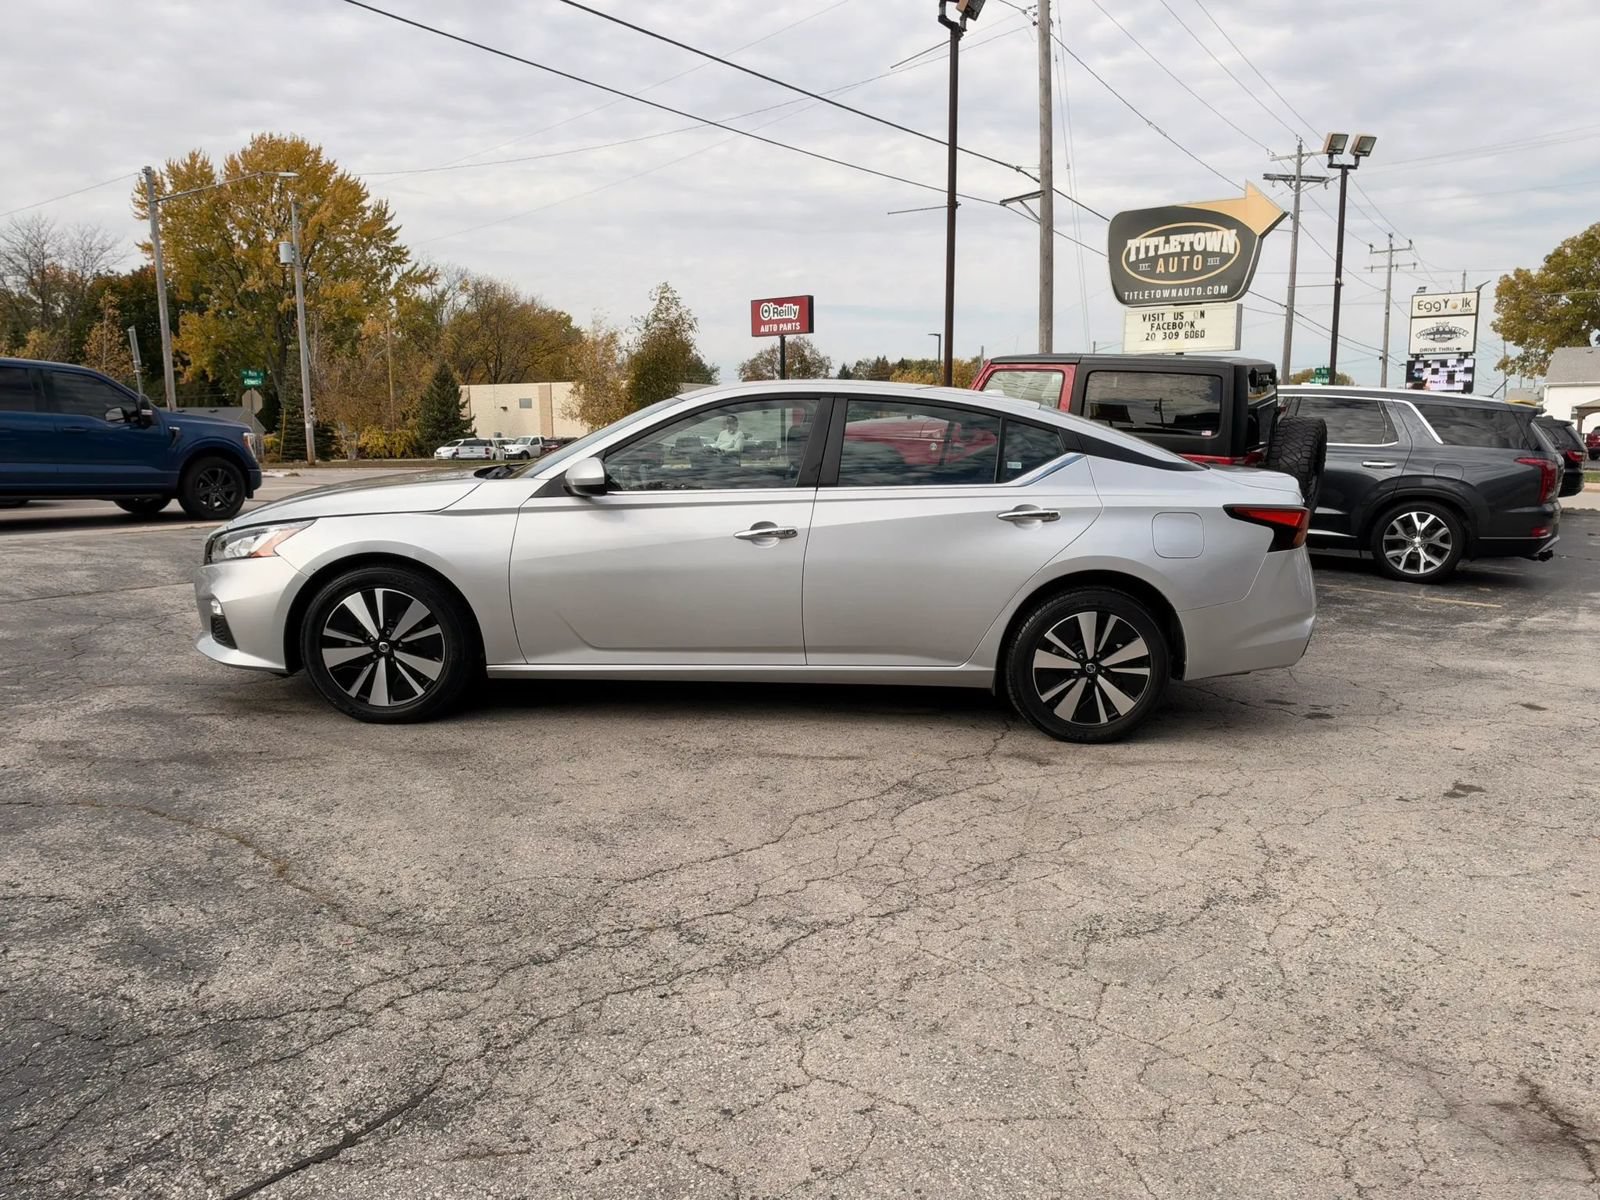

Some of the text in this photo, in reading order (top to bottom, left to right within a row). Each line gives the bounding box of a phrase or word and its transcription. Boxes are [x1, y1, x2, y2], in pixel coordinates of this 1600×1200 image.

[1127, 229, 1237, 262] TITLETOWN
[1156, 254, 1203, 274] AUTO
[1124, 285, 1228, 300] TITLETOWNAUTO.COM
[761, 304, 800, 320] O'Reilly
[1142, 313, 1165, 322] VISIT
[1174, 312, 1184, 320] US
[780, 322, 800, 331] PARTS
[1162, 332, 1180, 340] 309
[1184, 330, 1205, 339] 6060
